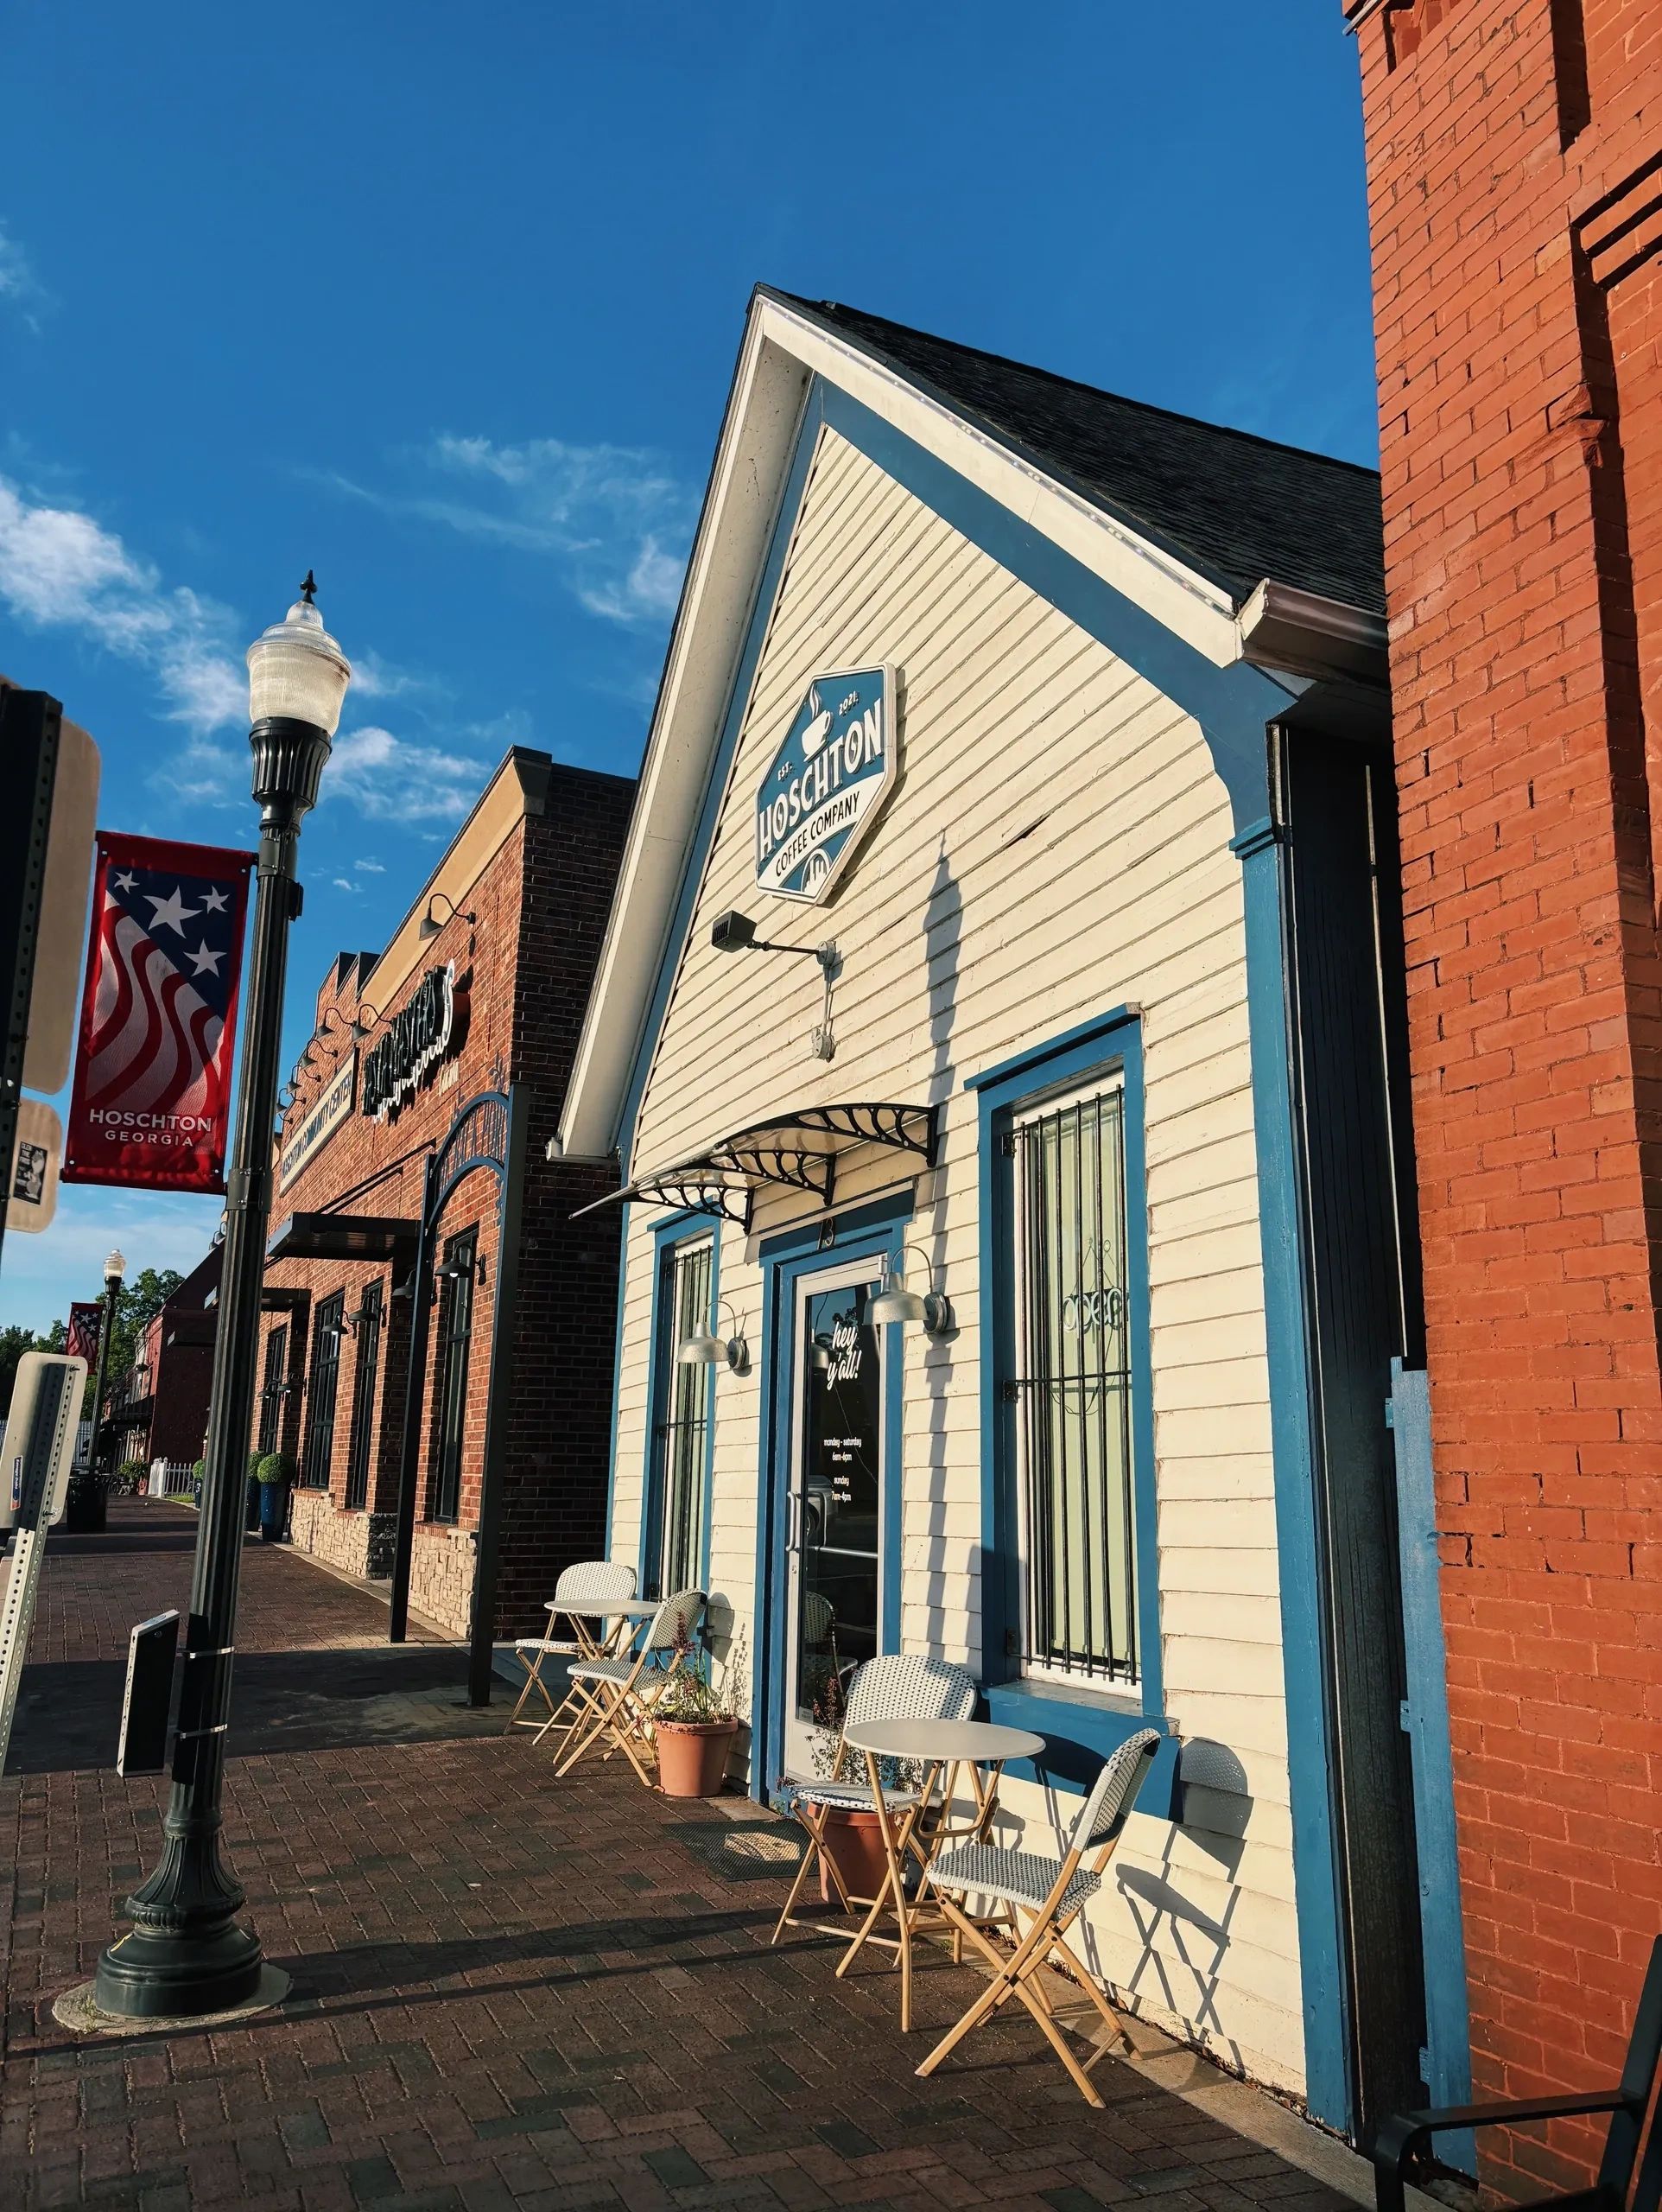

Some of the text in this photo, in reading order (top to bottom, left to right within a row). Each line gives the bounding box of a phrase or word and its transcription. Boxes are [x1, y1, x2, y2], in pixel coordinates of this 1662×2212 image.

[758, 698, 885, 863] HOSCHTON
[777, 761, 793, 781] EST.
[776, 791, 860, 876] COFFEE COMPANY
[328, 1069, 352, 1119] CENTER
[89, 1109, 212, 1132] HOSCHTON
[105, 1129, 193, 1147] GEORGIA
[832, 1321, 858, 1355] hey
[827, 1350, 862, 1391] y'all!
[823, 1437, 841, 1448] monday
[843, 1436, 862, 1448] saturday
[834, 1475, 850, 1486] sunday
